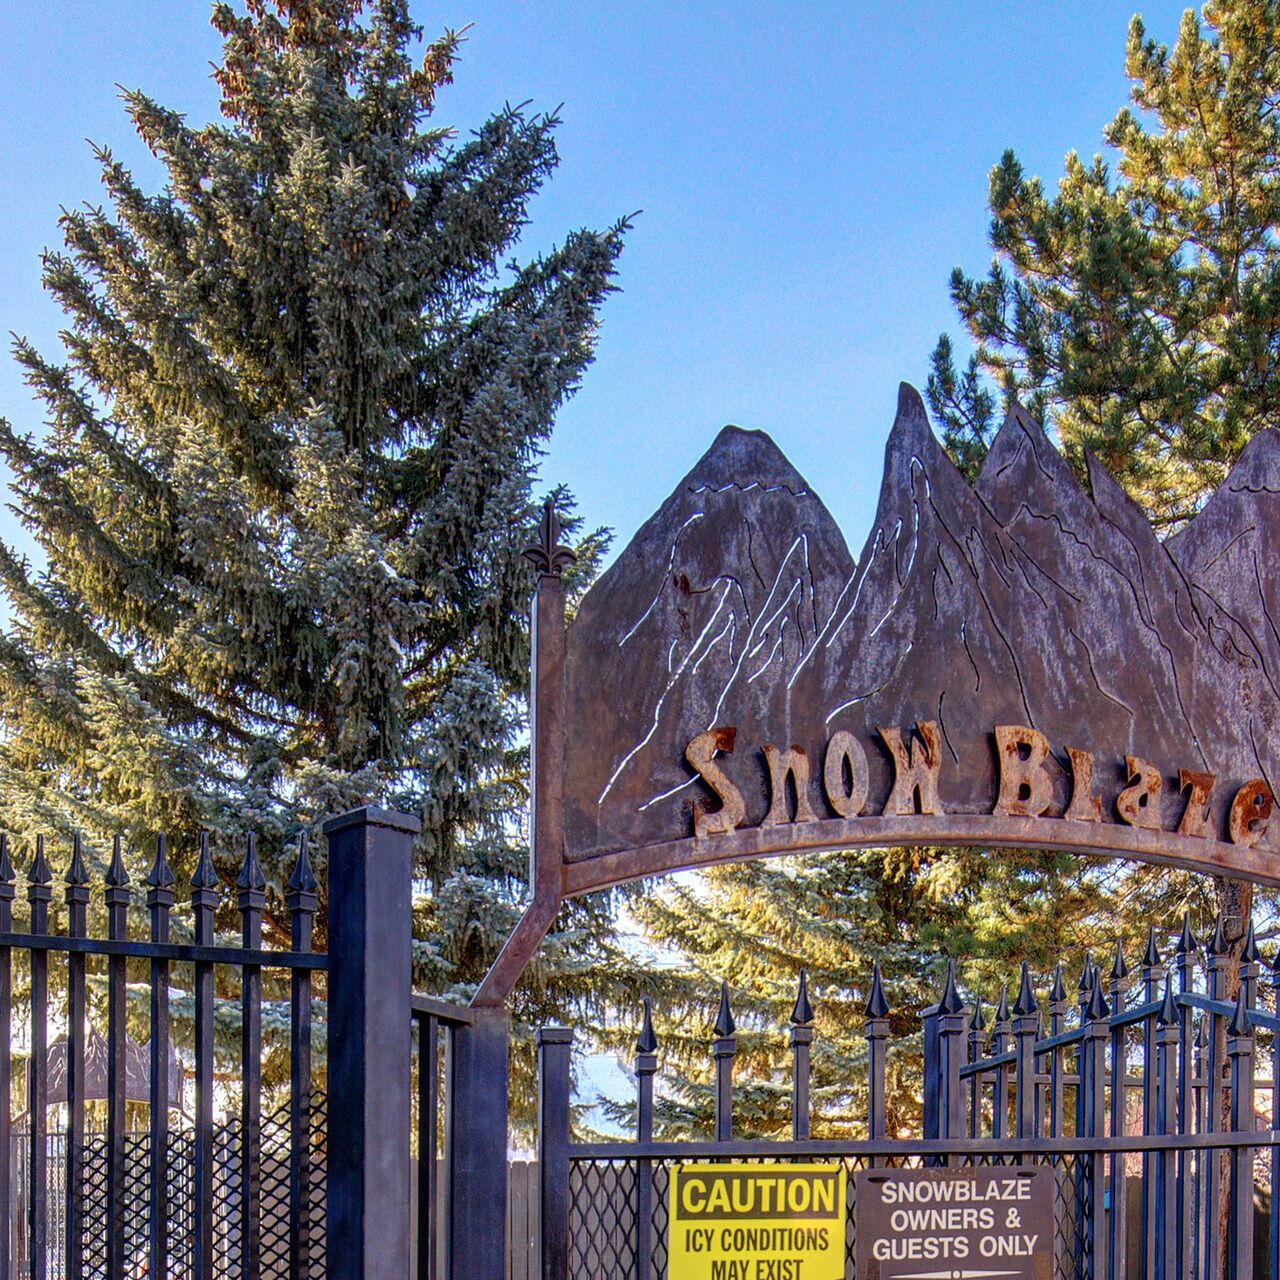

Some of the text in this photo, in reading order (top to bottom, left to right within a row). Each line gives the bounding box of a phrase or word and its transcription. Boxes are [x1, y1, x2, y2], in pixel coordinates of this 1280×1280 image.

[681, 1178, 835, 1214] CAUTION
[881, 1179, 1032, 1203] SNOWBLAZE
[890, 1207, 1022, 1231] OWNERS &
[685, 1227, 830, 1253] ICY CONDITIONS
[872, 1234, 1039, 1260] GUESTS ONLY
